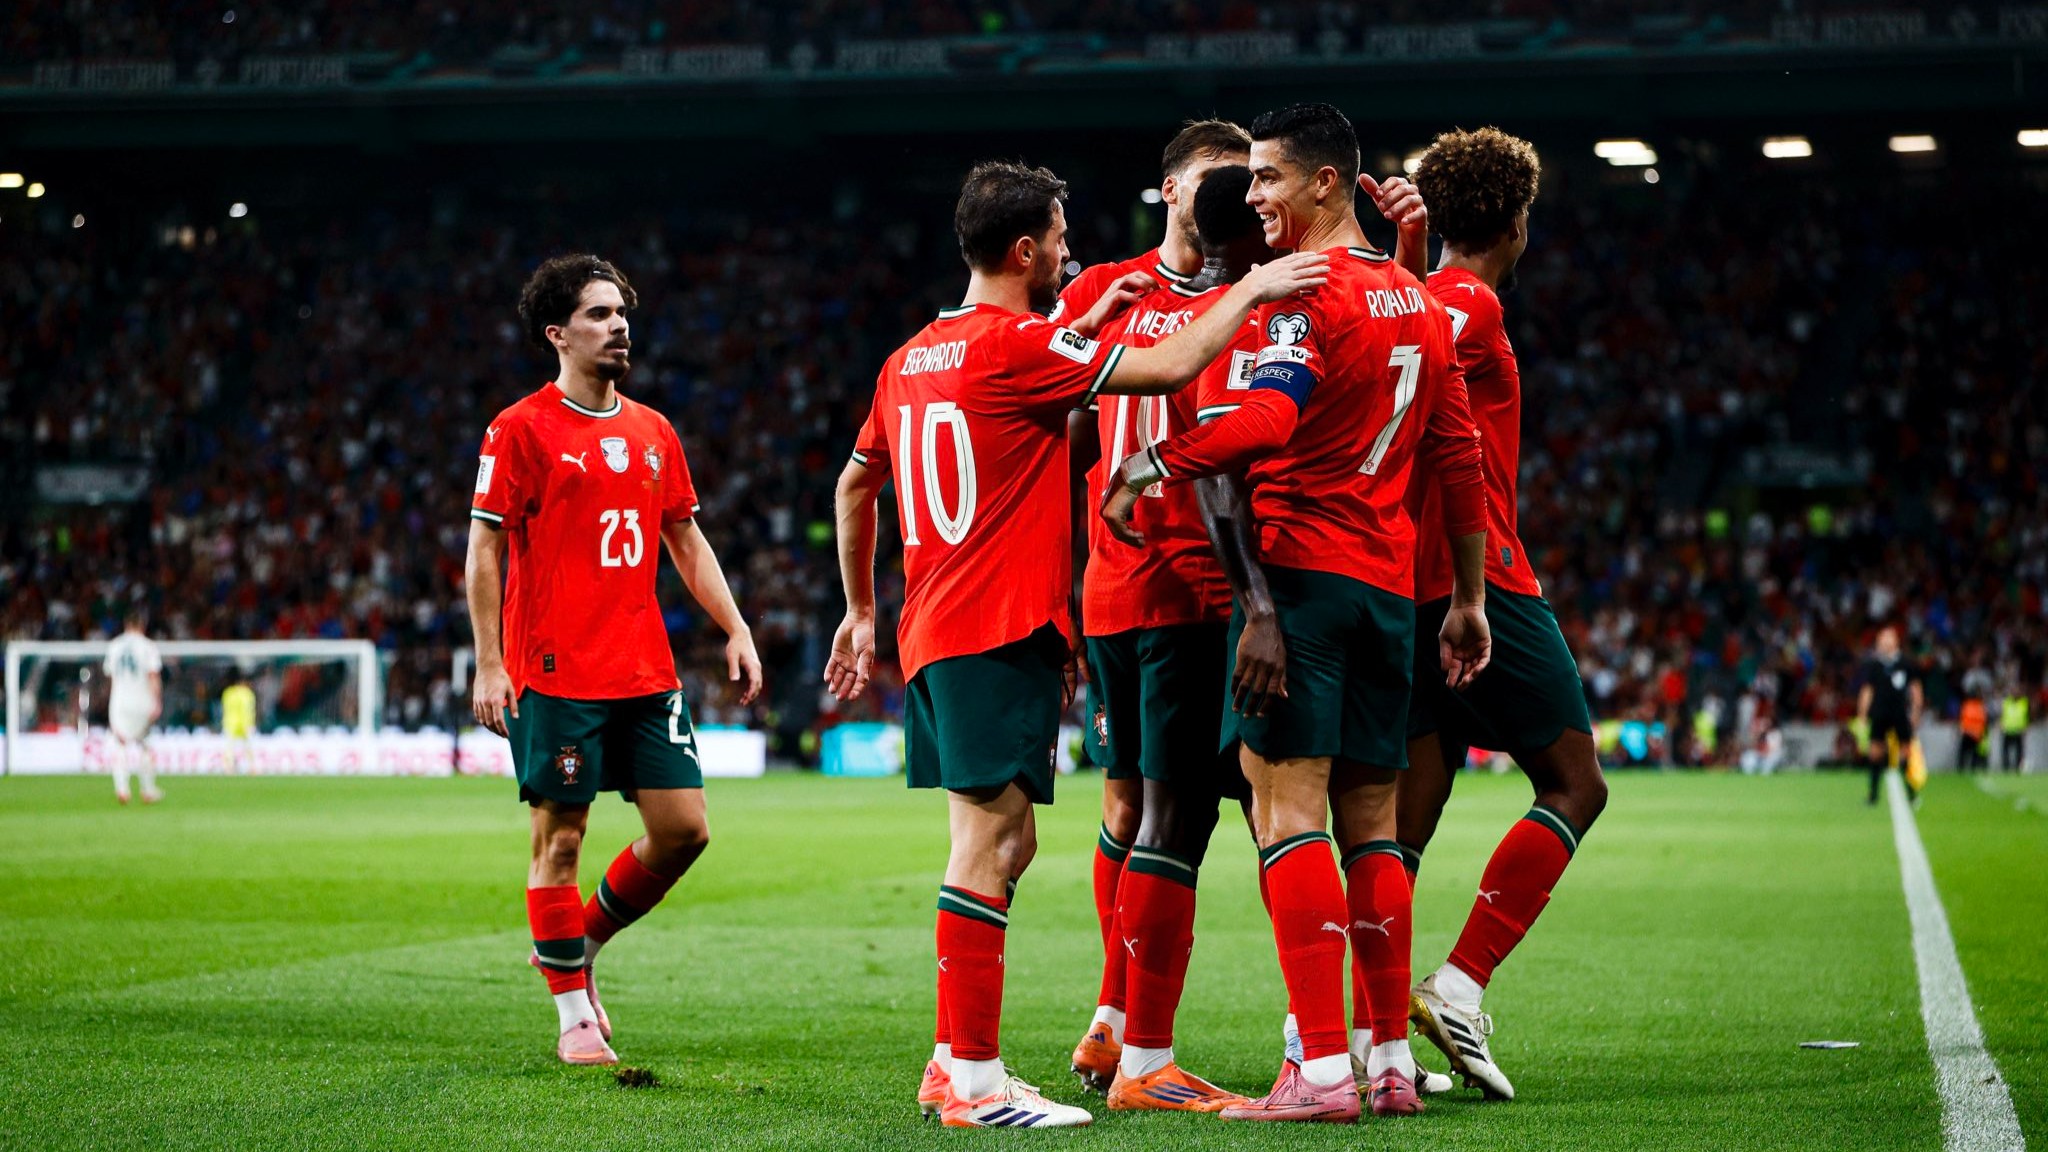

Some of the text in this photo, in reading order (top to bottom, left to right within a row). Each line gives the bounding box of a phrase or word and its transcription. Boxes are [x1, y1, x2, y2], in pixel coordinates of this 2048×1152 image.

[899, 340, 967, 376] BERNARDO
[1254, 368, 1294, 381] RESPECT
[1358, 345, 1422, 475] 7
[898, 402, 977, 546] 10
[599, 509, 644, 568] 23
[666, 690, 694, 744] 2
